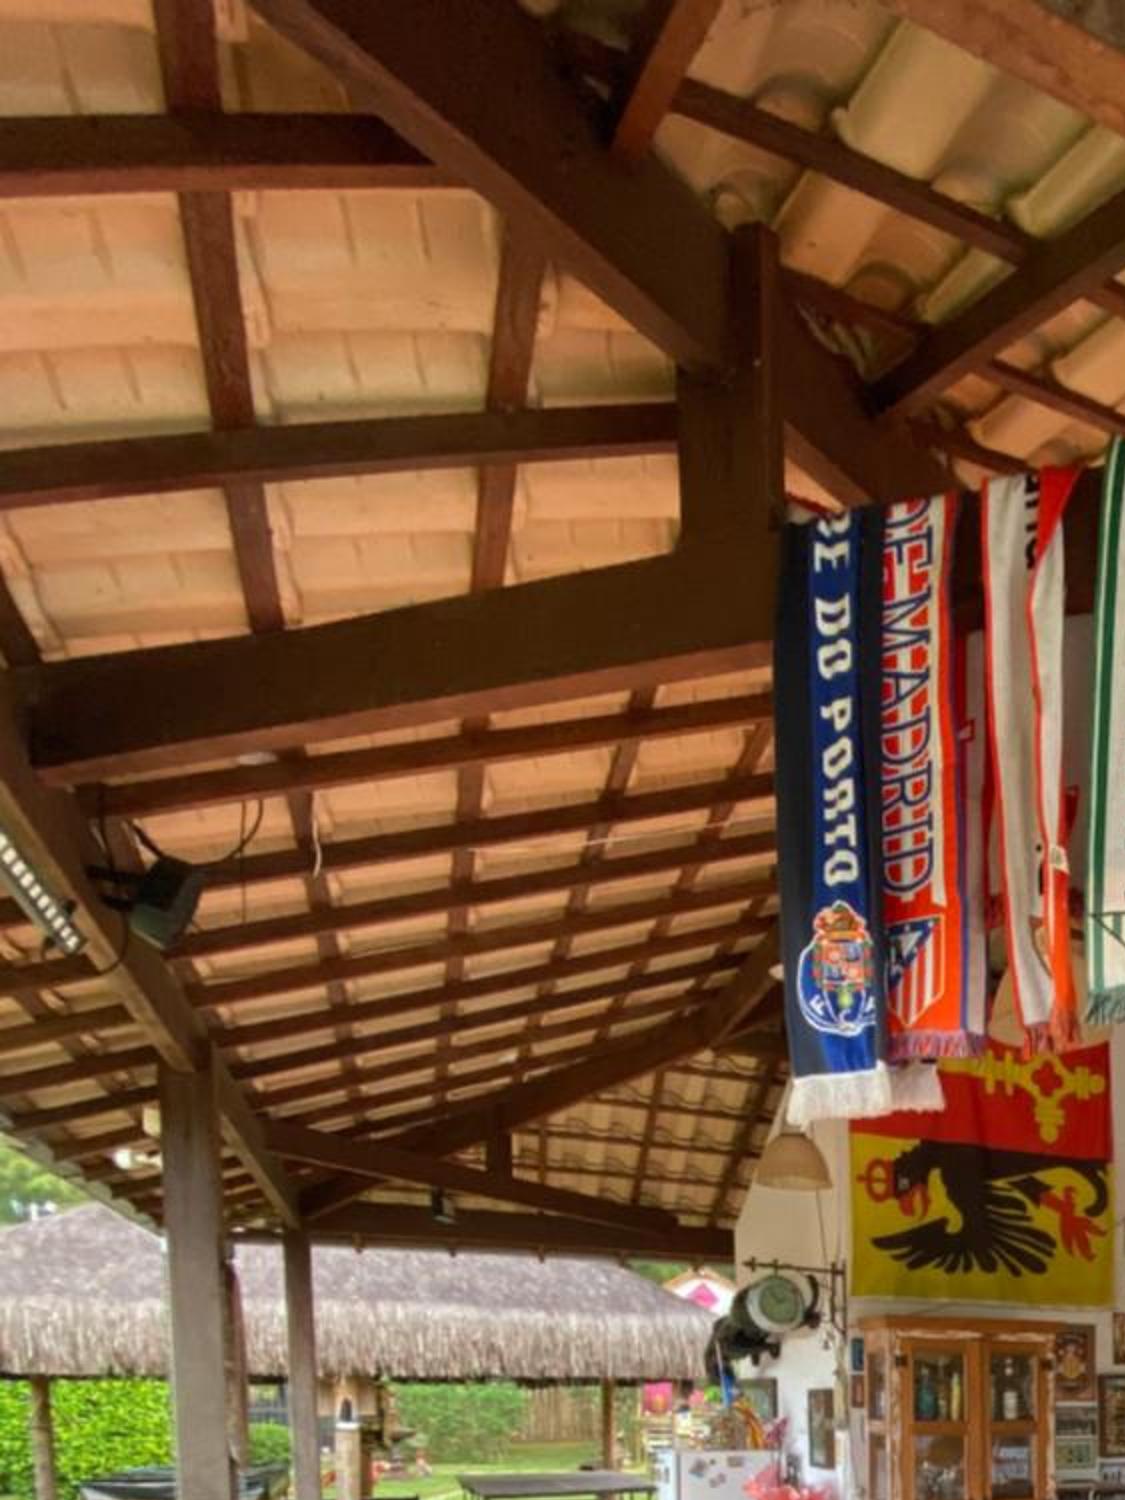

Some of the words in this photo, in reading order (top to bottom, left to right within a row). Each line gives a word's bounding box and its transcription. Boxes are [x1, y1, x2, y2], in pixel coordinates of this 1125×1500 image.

[815, 594, 854, 681] DO
[819, 697, 860, 888] PORTO
[881, 588, 934, 895] MADRID
